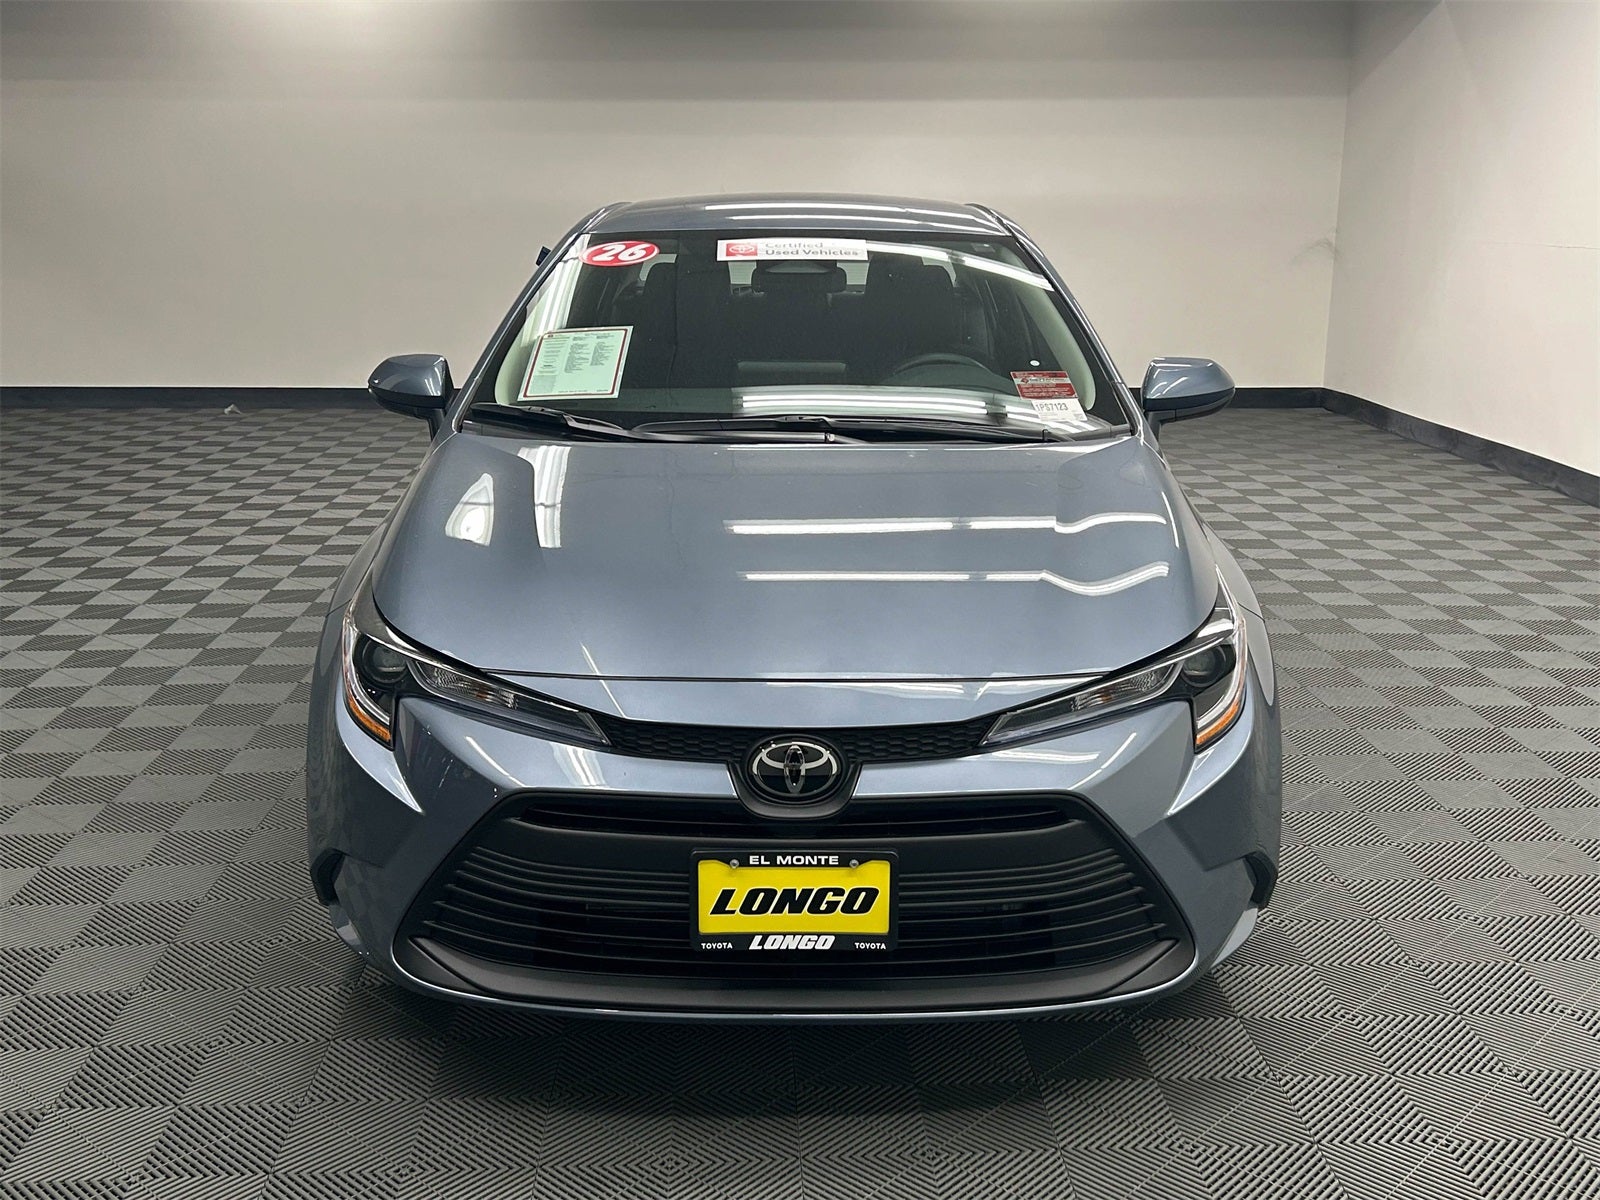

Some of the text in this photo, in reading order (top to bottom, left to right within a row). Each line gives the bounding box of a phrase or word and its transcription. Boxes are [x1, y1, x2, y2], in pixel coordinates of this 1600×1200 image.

[592, 243, 651, 261] 26
[749, 855, 839, 865] EL MONTE
[709, 887, 880, 915] LONGO
[749, 934, 836, 950] LONGO
[854, 942, 886, 950] TOYOTA
